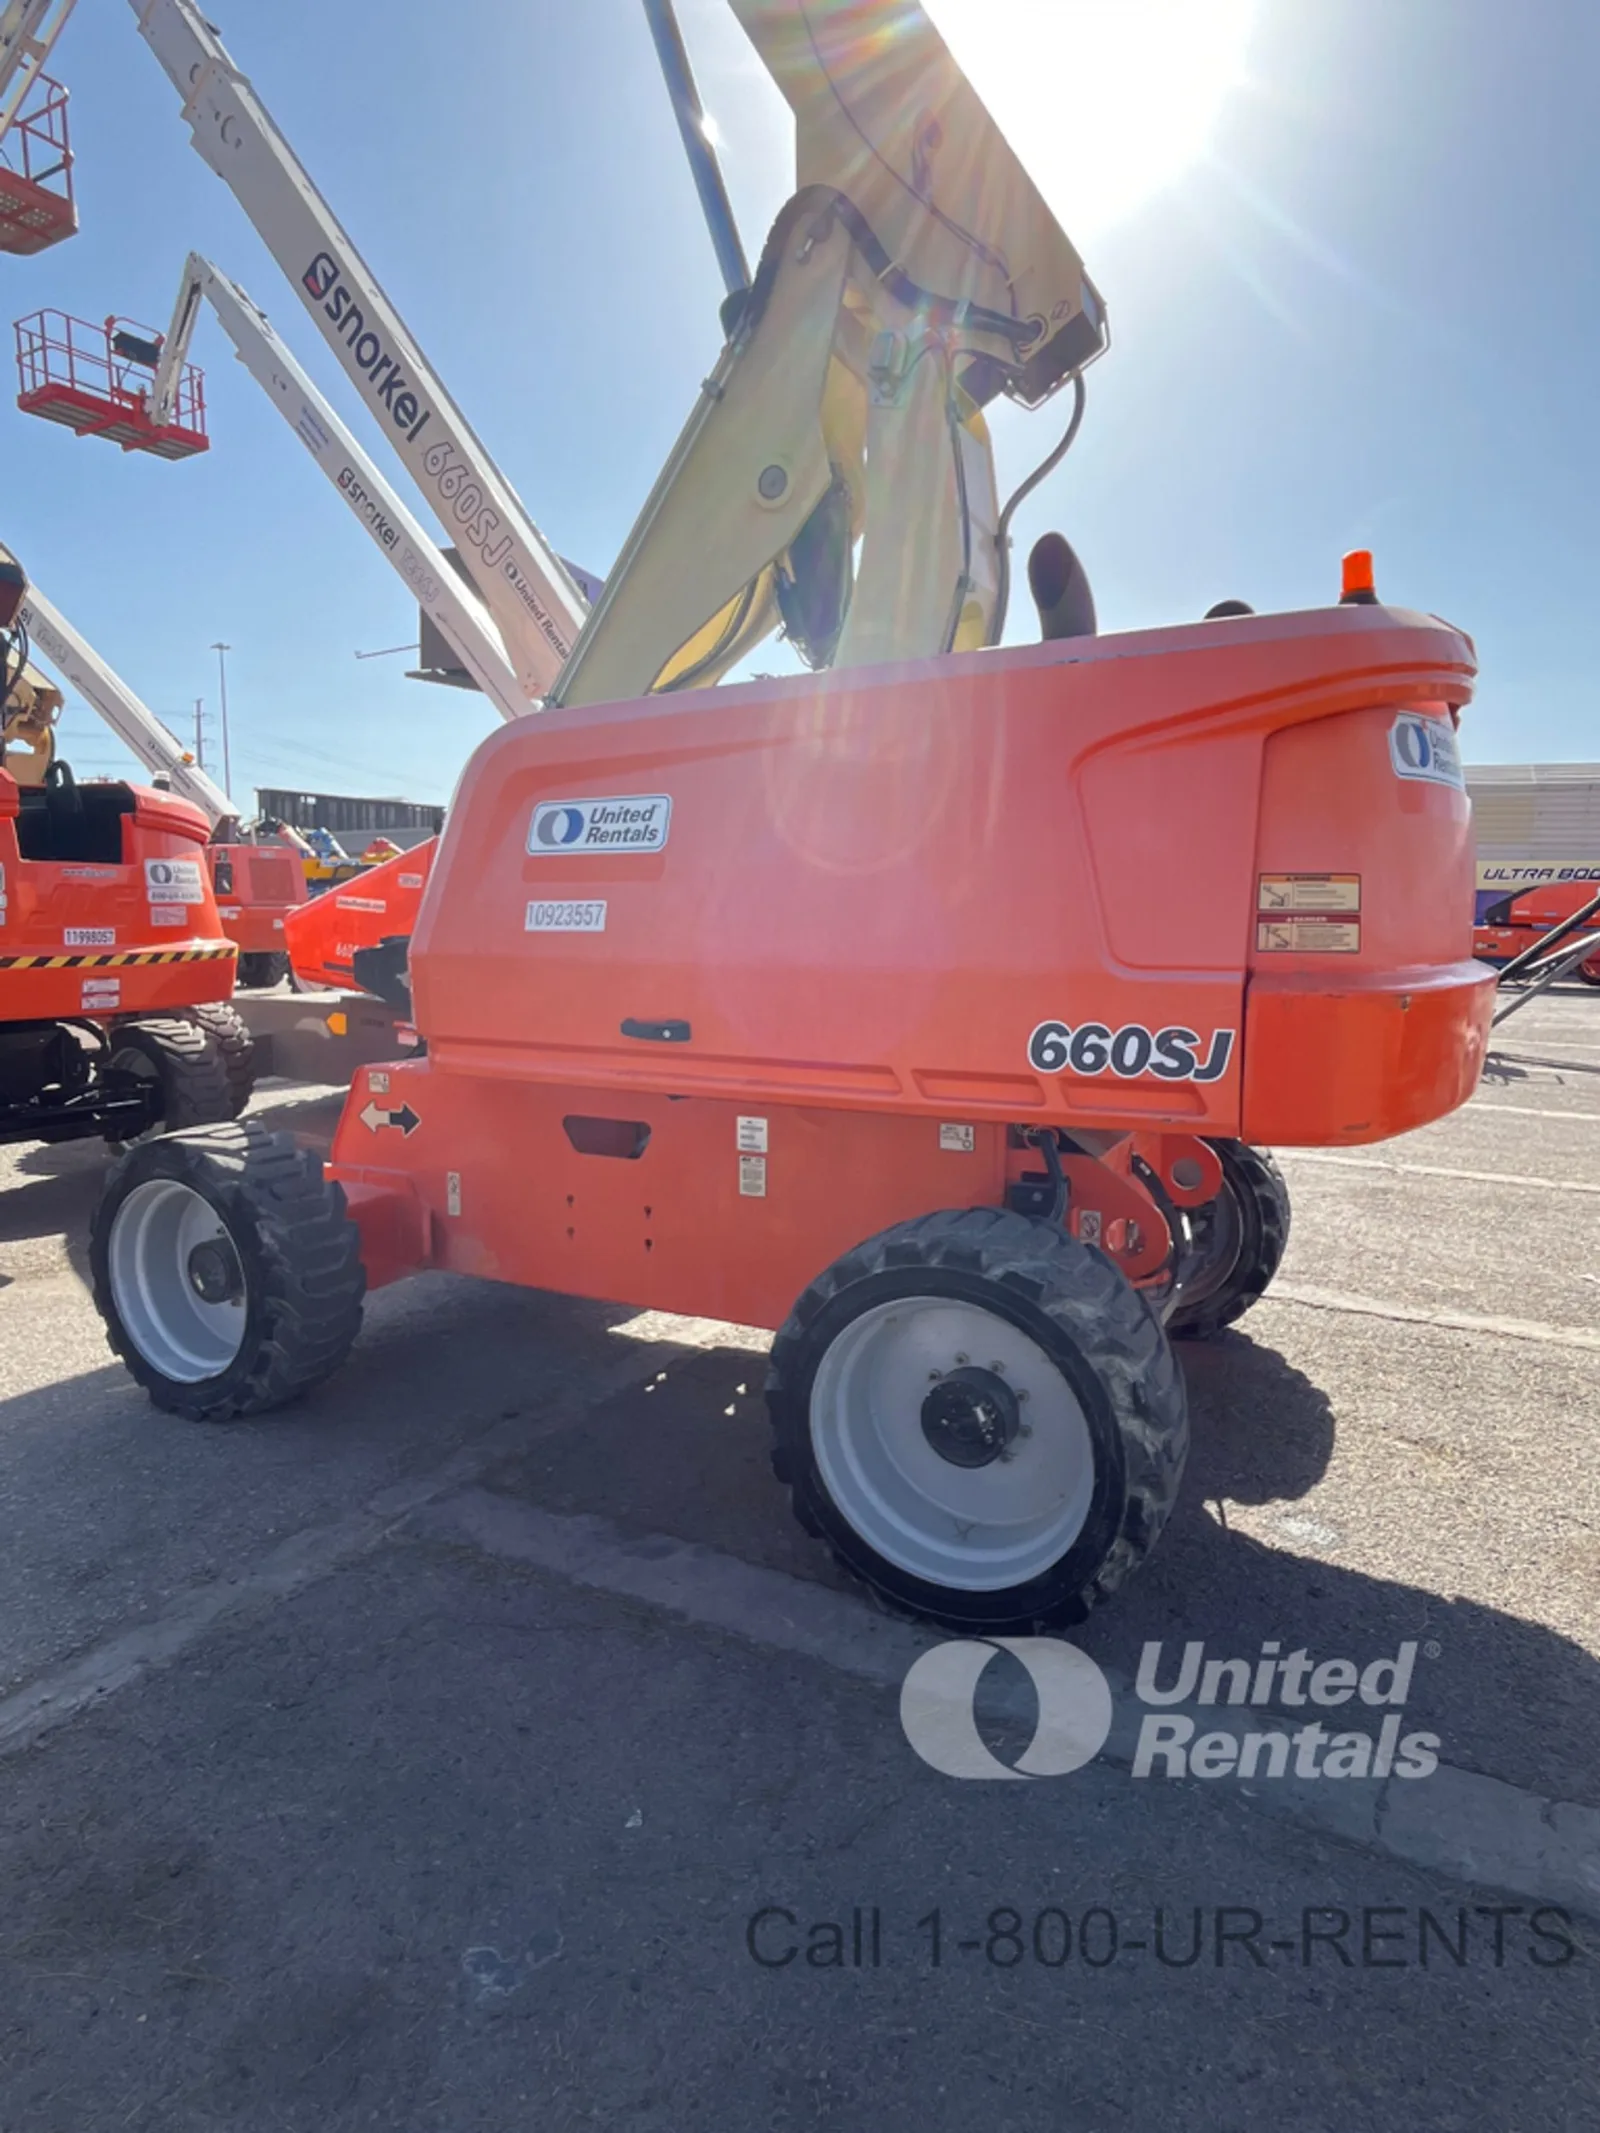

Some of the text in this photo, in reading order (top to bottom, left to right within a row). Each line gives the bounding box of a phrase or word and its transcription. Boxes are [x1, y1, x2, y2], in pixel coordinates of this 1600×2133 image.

[324, 285, 431, 443] snorkel
[423, 441, 514, 568] 660SJ
[348, 480, 400, 551] snorkel
[514, 579, 571, 660] United Renta
[589, 804, 656, 824] United
[585, 825, 660, 844] Rentals
[1483, 867, 1555, 880] ULTRA
[528, 903, 605, 926] 10923557
[66, 929, 114, 944] 11998057
[1028, 1020, 1235, 1082] 660SJ
